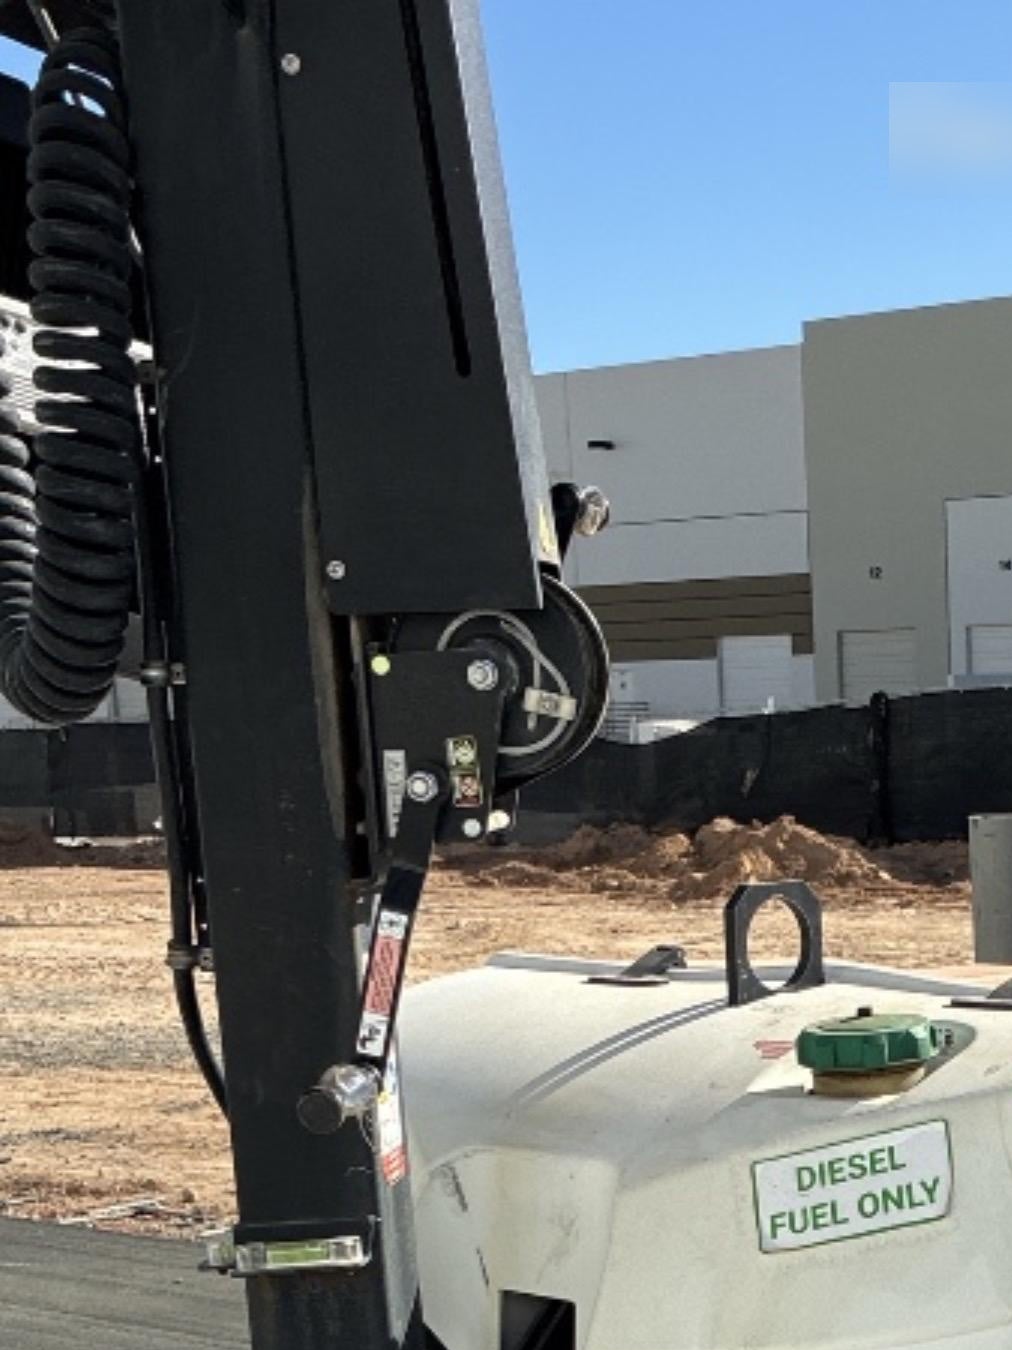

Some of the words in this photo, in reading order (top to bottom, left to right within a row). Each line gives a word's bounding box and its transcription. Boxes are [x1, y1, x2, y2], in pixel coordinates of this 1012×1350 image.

[796, 1145, 906, 1192] DIESEL
[769, 1201, 850, 1240] FUEL
[858, 1177, 941, 1218] ONLY
